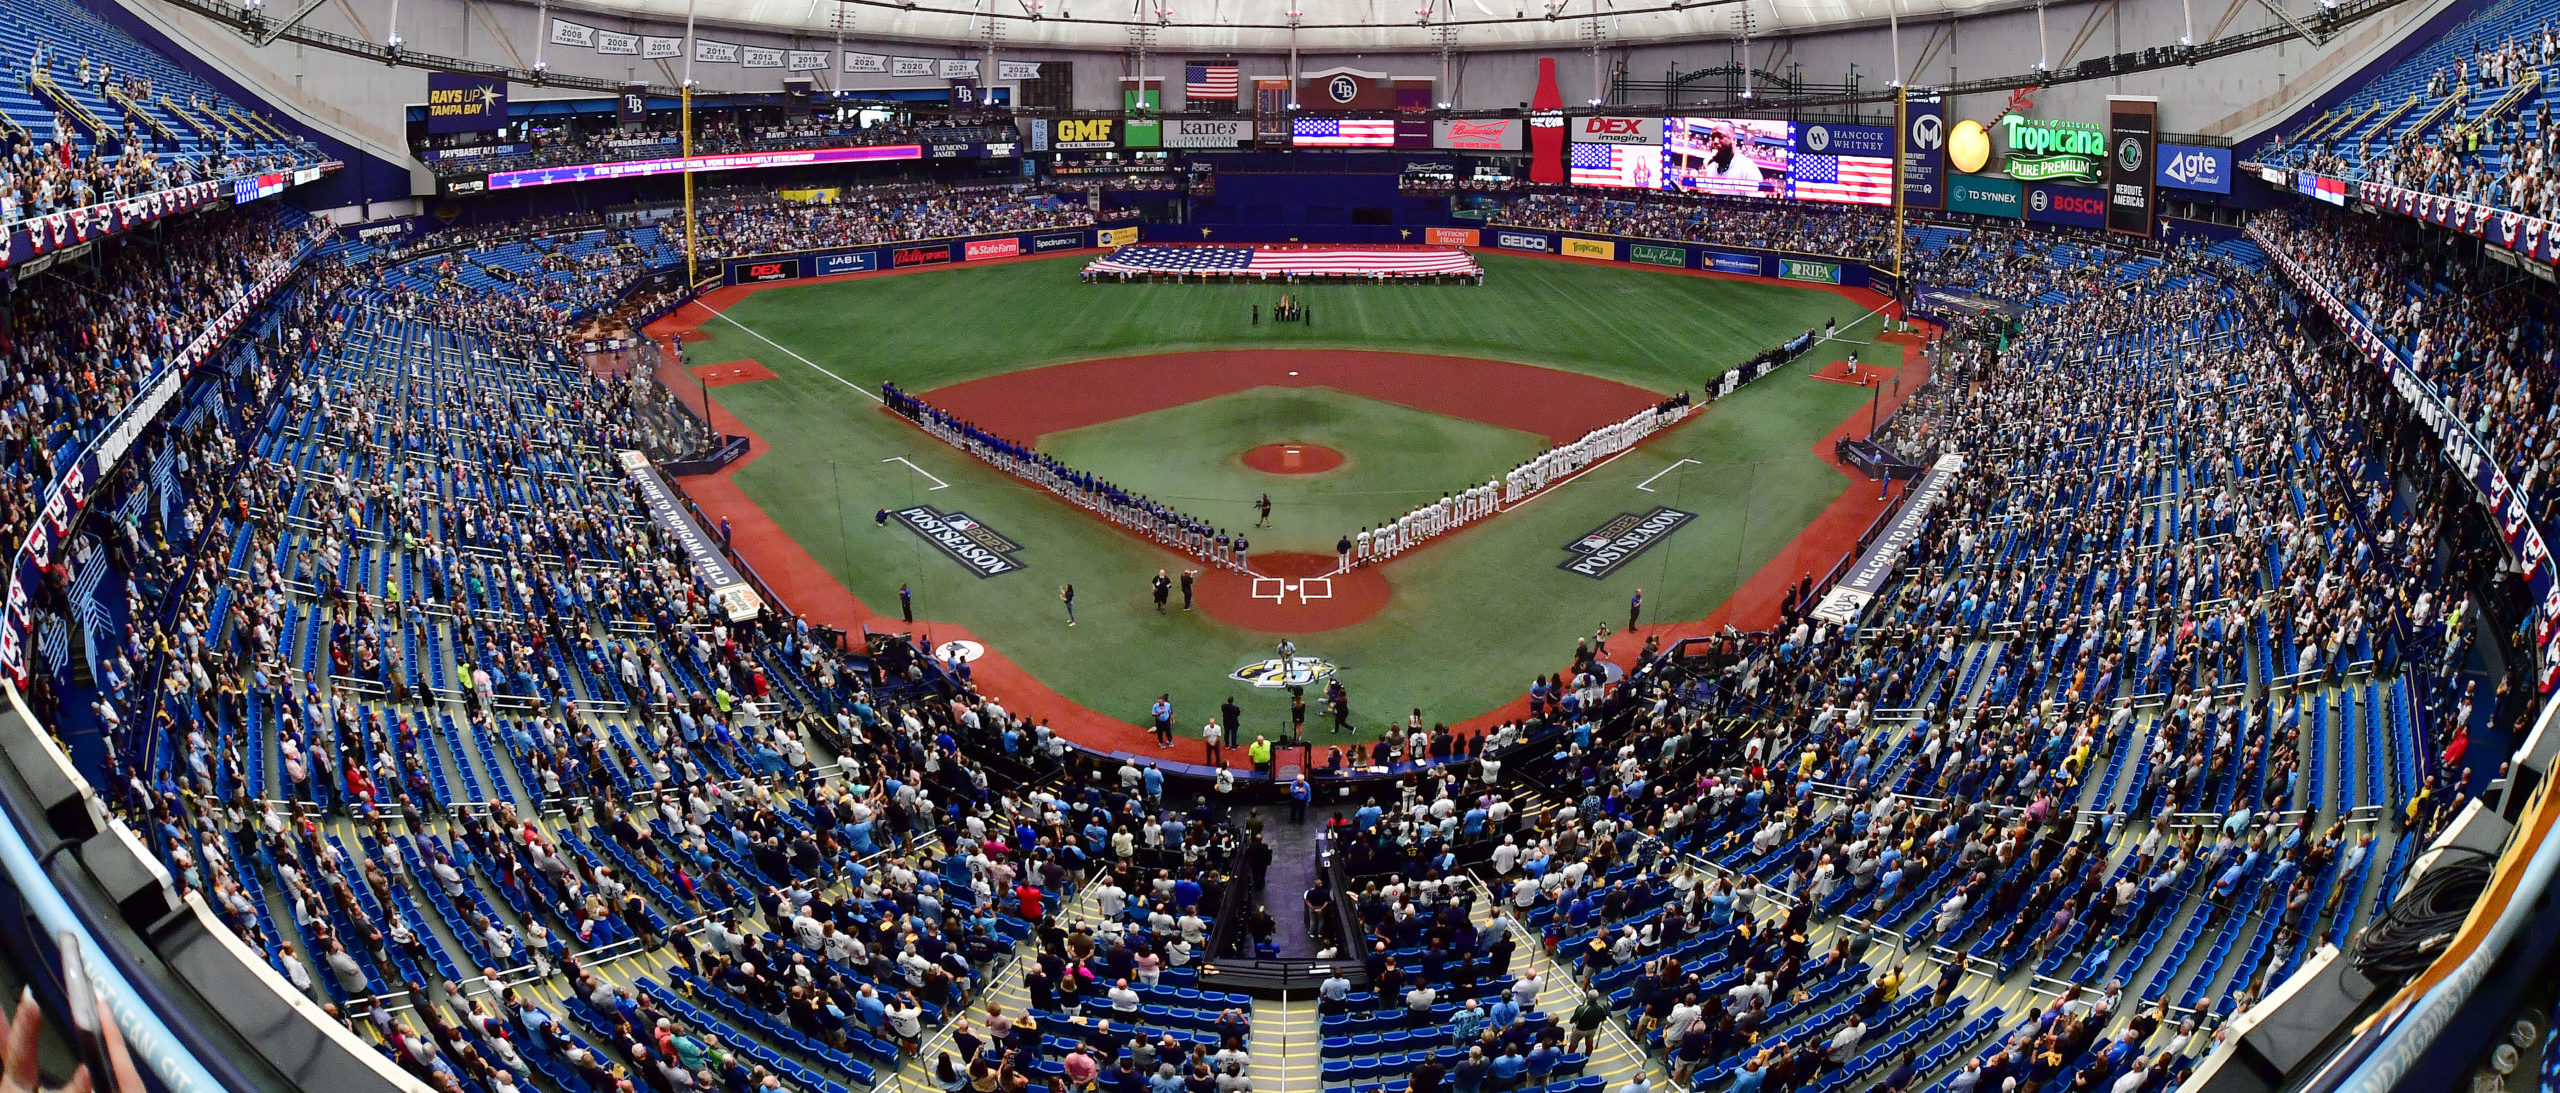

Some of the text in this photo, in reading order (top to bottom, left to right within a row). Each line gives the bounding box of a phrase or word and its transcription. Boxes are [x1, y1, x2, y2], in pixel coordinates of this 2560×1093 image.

[562, 29, 582, 39] 2008
[556, 36, 587, 46] CHAMPIONS
[607, 38, 628, 47] 2008
[601, 45, 633, 53] CHAMPIONS
[706, 47, 726, 55] 2011
[955, 86, 972, 103] TB
[1334, 80, 1353, 98] TB
[430, 89, 480, 103] RAYS UP
[431, 103, 483, 116] TAMPA BAY
[625, 94, 643, 113] TB
[1035, 121, 1045, 129] 42
[1058, 119, 1112, 141] GMF
[1180, 120, 1237, 135] kanes
[1455, 124, 1504, 136] Budweiser
[1585, 118, 1643, 135] DEX
[2061, 122, 2100, 130] ORIGINAL
[1598, 134, 1648, 143] imaging
[1834, 130, 1884, 141] HANCOCK
[2002, 114, 2105, 155] Tropicana
[933, 144, 969, 152] RAYMOND
[1834, 141, 1884, 150] WHITNEY
[2012, 160, 2089, 176] PURE PREMIUM
[2185, 152, 2217, 178] gte
[2191, 173, 2220, 184] financial
[1968, 190, 2016, 204] TD SYNNEX
[2115, 184, 2143, 197] REROUTE
[2054, 195, 2104, 215] BOSCH
[2113, 195, 2145, 208] AMERICAS
[359, 224, 401, 239] SOMOS RAYS
[1436, 229, 1469, 237] BAYFRONT
[1440, 236, 1466, 244] HEALTH
[1500, 235, 1546, 249] GEICO
[1573, 242, 1604, 255] Tropicana
[829, 255, 864, 266] JABIL
[895, 249, 925, 264] Bally
[1633, 247, 1682, 264] Quality Roofing
[751, 264, 782, 276] DEX
[1801, 265, 1829, 278] RIPA
[633, 468, 731, 585] WELCOME TO TROPICANA FIELD
[1601, 515, 1640, 539] 2023
[1852, 471, 1949, 587] WELCOME TO TROPICANA FIELD
[900, 508, 1012, 574] POSTSEASON
[966, 527, 1011, 552] 2023
[1572, 509, 1686, 575] POSTSEASON
